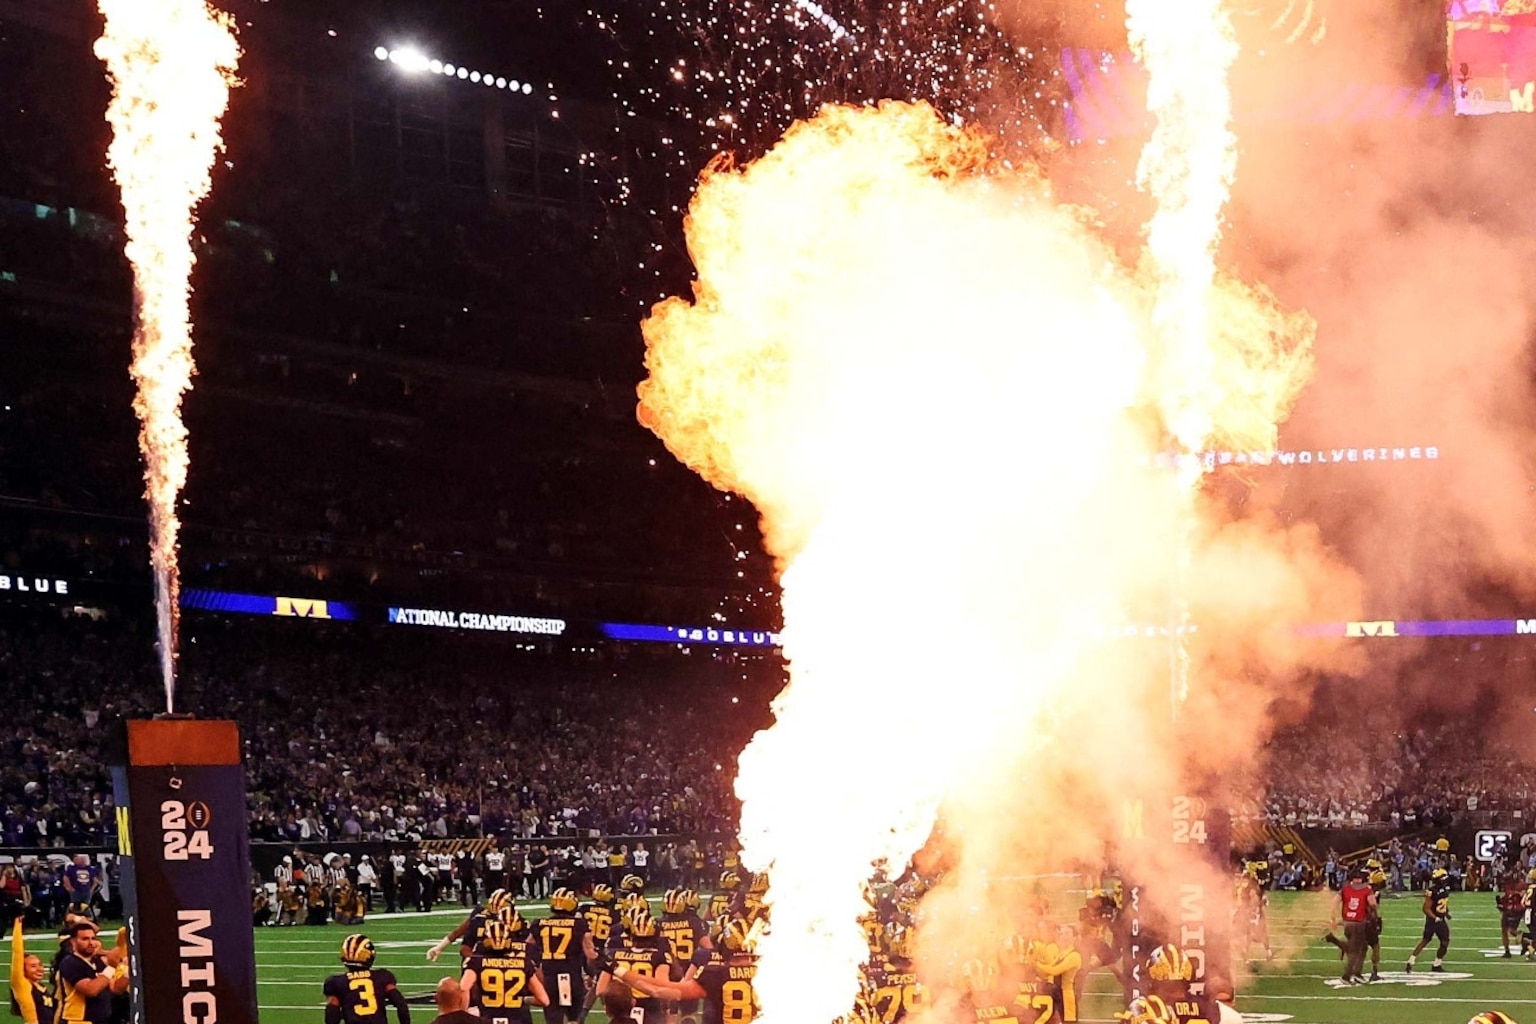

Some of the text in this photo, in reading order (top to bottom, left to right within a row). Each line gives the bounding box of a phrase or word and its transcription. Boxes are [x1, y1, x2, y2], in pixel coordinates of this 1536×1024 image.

[388, 607, 566, 635] NATIONAL CHAMPIONSHIP
[163, 830, 214, 860] 24
[540, 926, 573, 960] 17
[481, 957, 525, 969] ANDERSON
[348, 978, 378, 1017] 3
[480, 969, 526, 1009] 92
[975, 1005, 1009, 1020] KLEIN
[1175, 1001, 1200, 1017] ORJI
